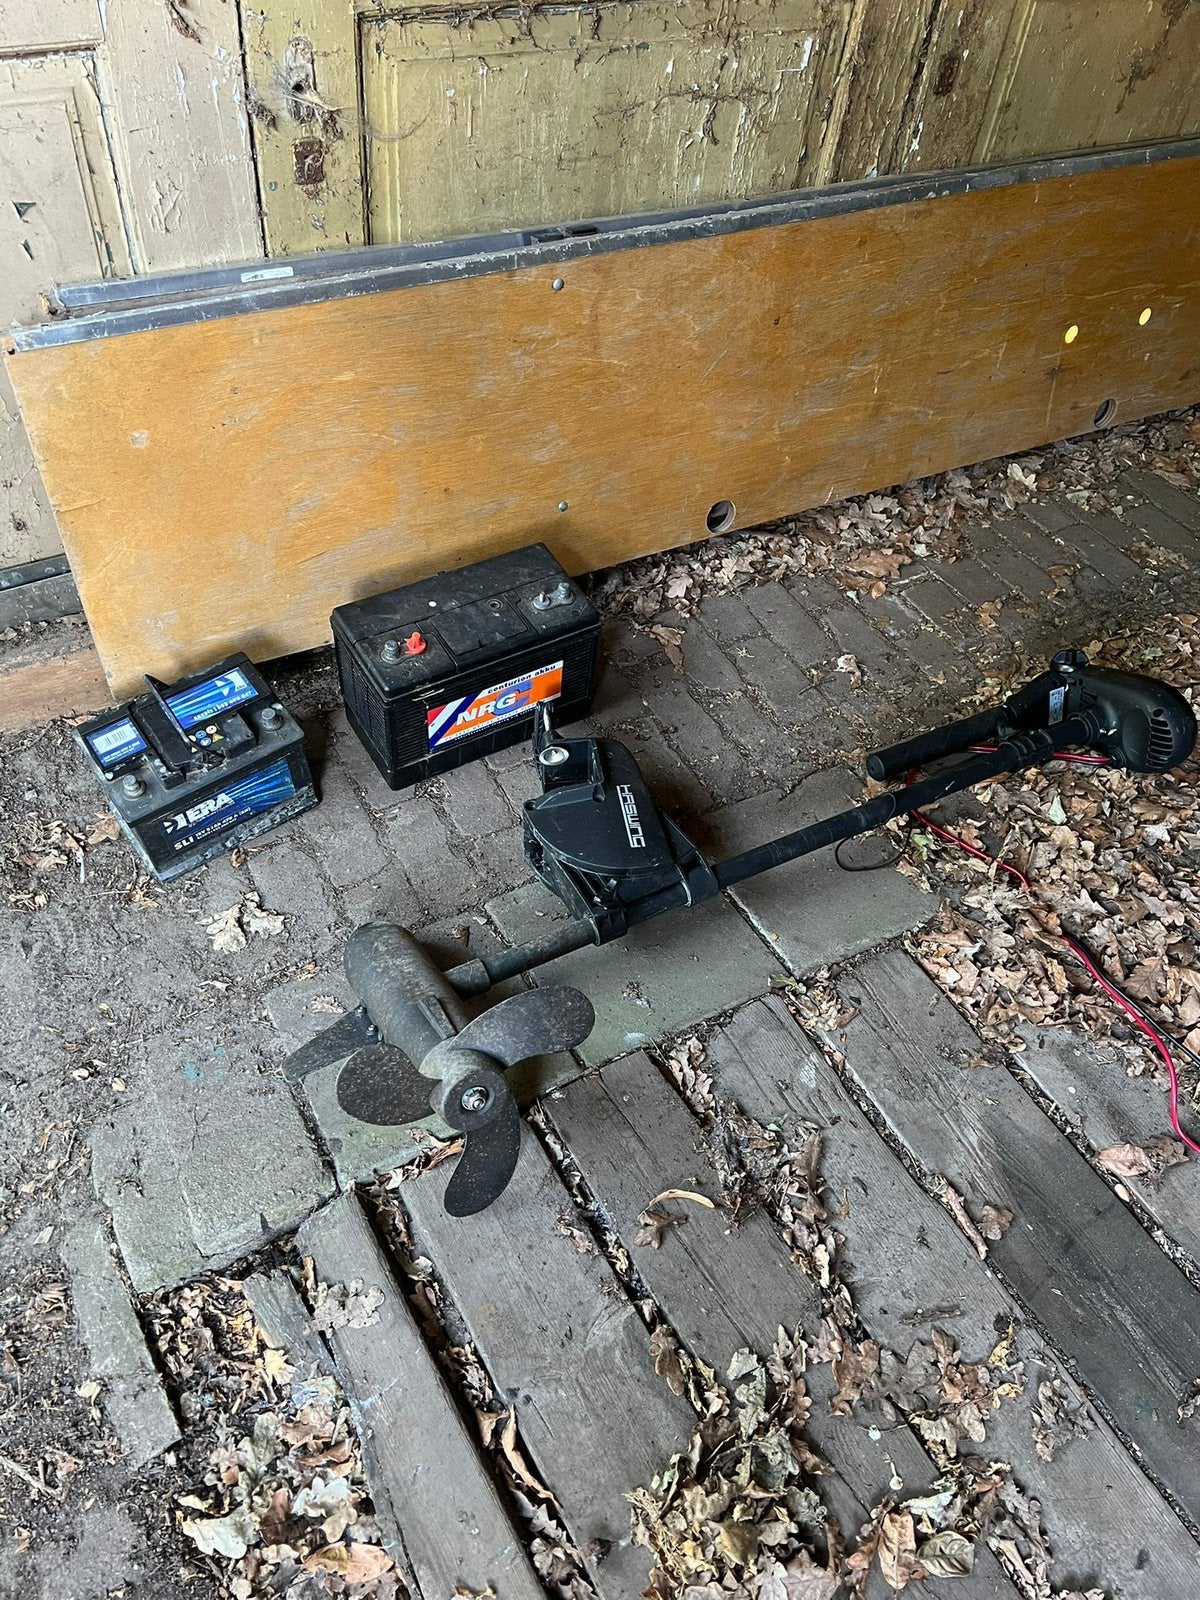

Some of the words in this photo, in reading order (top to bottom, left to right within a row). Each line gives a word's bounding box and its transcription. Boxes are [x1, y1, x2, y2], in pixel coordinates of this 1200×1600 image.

[487, 674, 532, 694] centurion
[534, 664, 556, 677] akku
[456, 692, 518, 726] NRG
[616, 784, 646, 848] HASWING
[174, 835, 195, 850] SLI
